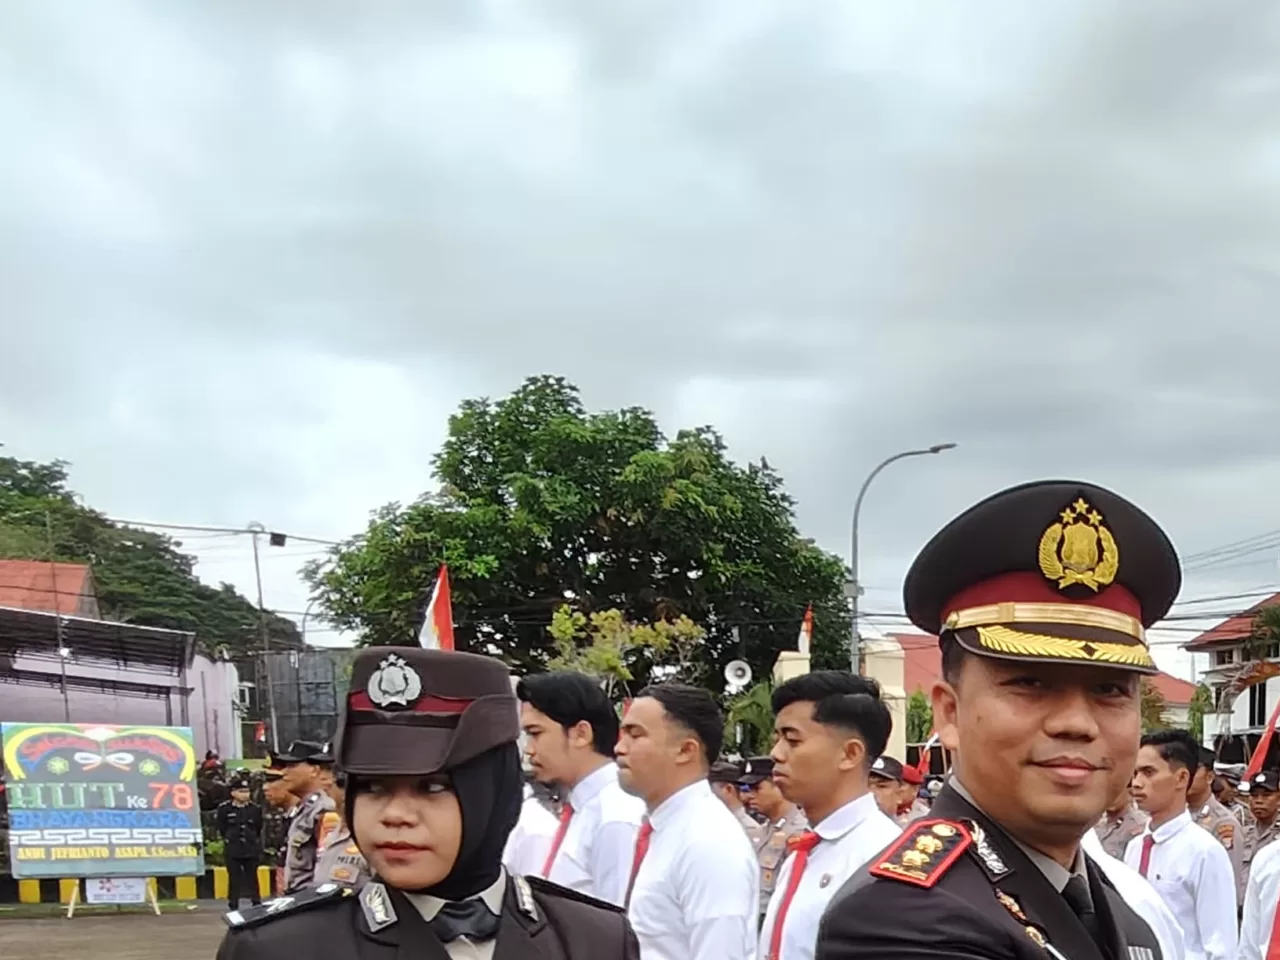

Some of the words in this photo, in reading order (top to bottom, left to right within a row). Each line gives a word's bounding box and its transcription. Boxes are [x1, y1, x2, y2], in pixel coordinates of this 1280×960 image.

[6, 782, 125, 809] HUT
[126, 795, 148, 809] Ke
[148, 783, 194, 810] 78
[10, 811, 192, 828] BHAYANGKARA
